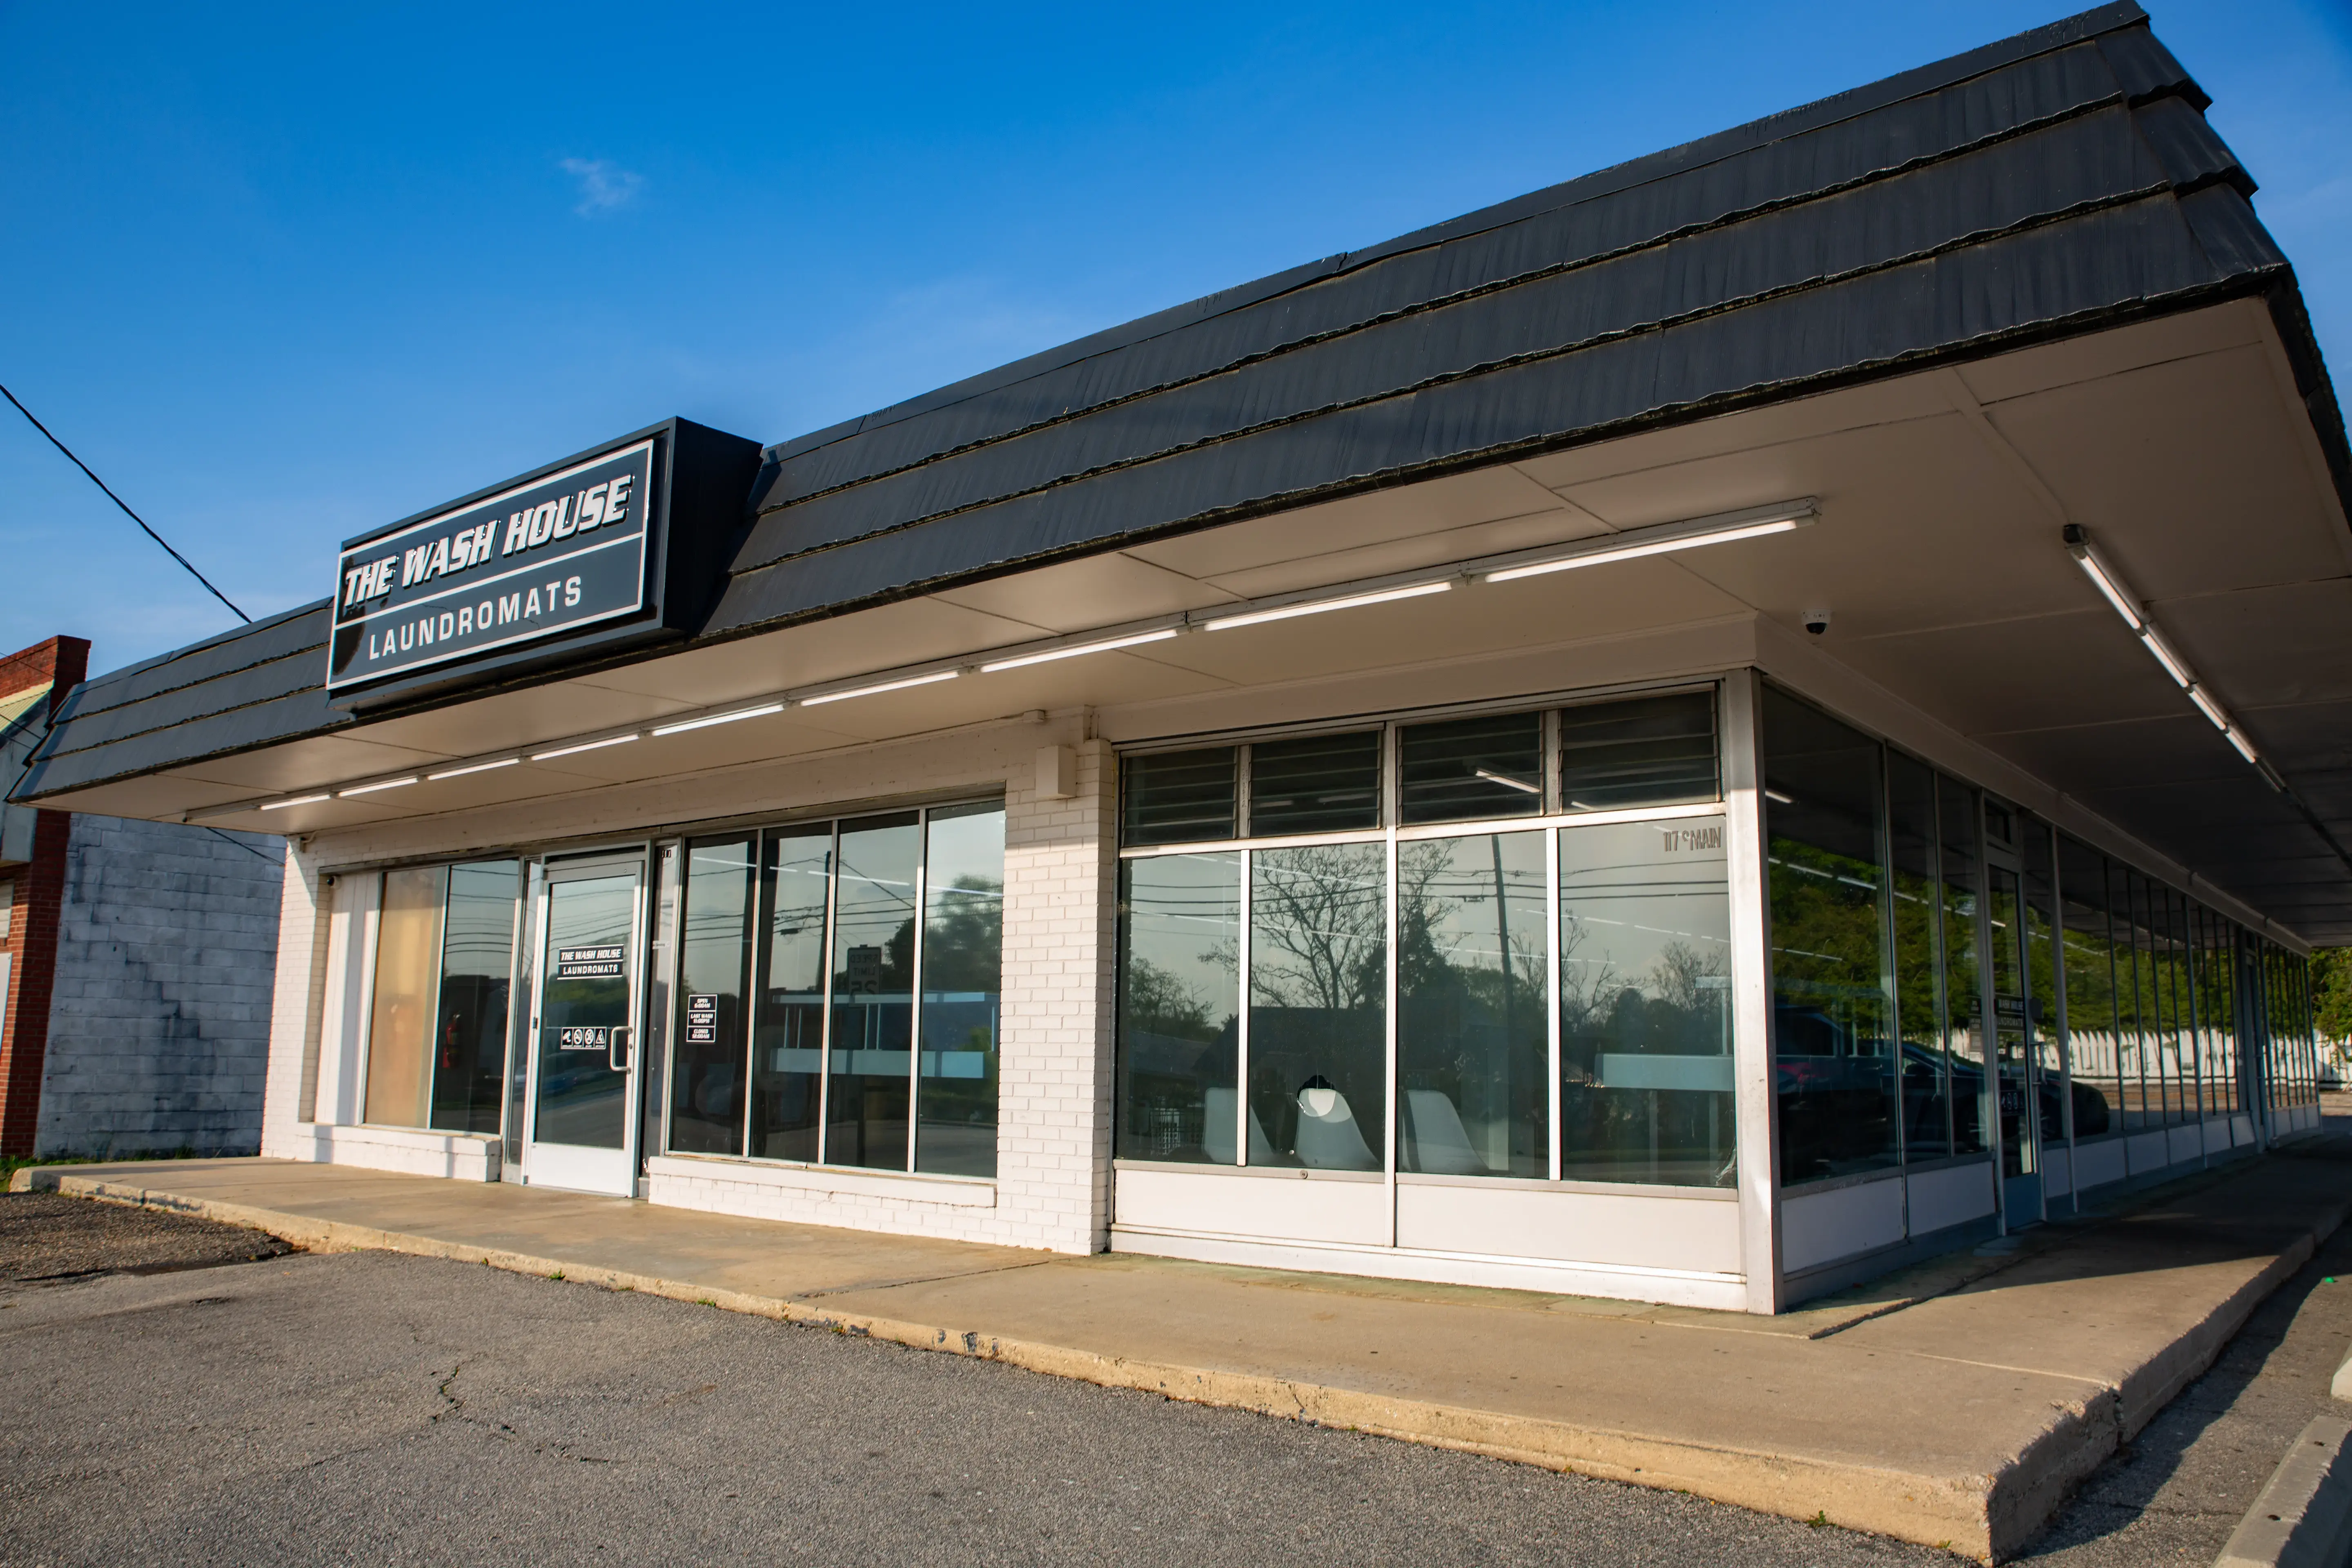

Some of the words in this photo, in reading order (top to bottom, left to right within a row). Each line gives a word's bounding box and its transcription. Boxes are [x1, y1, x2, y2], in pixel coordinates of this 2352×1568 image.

[344, 555, 398, 607] THE
[402, 521, 497, 588] WASH
[503, 474, 633, 556] HOUSE
[370, 576, 581, 660] LAUNDROMATS
[1663, 831, 1679, 852] 117
[1690, 826, 1722, 851] MAIN
[561, 951, 575, 961] THE
[575, 950, 596, 960] WASH
[597, 949, 621, 959] HOUSE
[563, 964, 618, 975] LAUNDROMATS
